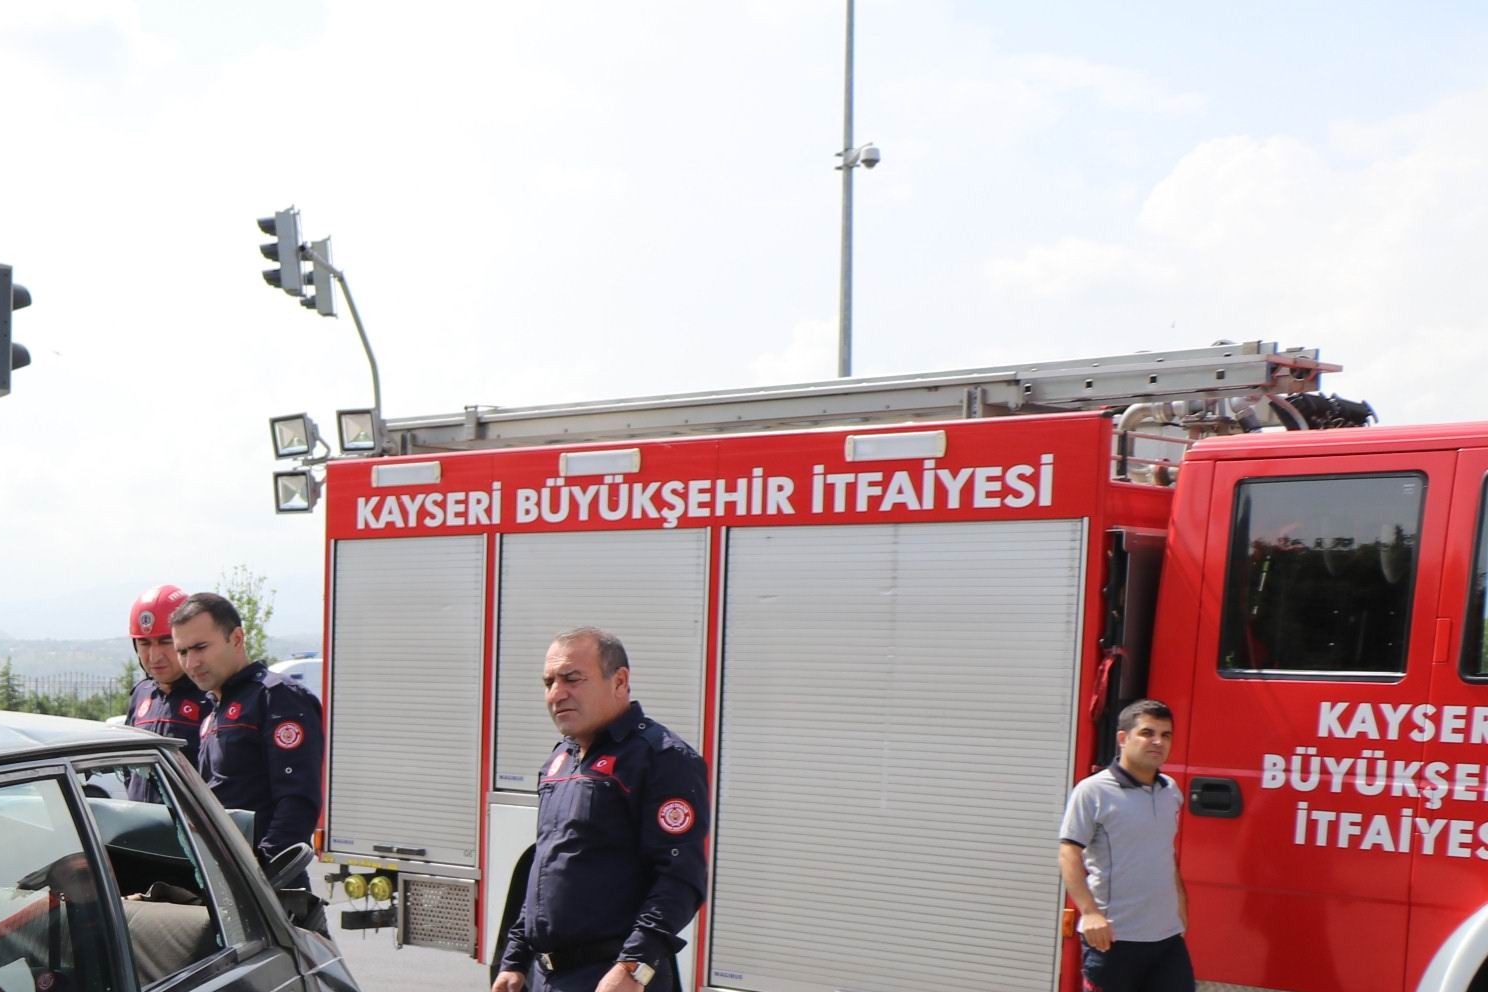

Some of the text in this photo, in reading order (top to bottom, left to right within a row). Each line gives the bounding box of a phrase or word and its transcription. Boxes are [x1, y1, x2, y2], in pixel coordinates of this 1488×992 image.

[356, 453, 1054, 530] KAYSERİ BÜYÜKŞEHİR İTFAİYESİ
[1262, 746, 1488, 810] BÜYÜKŞE
